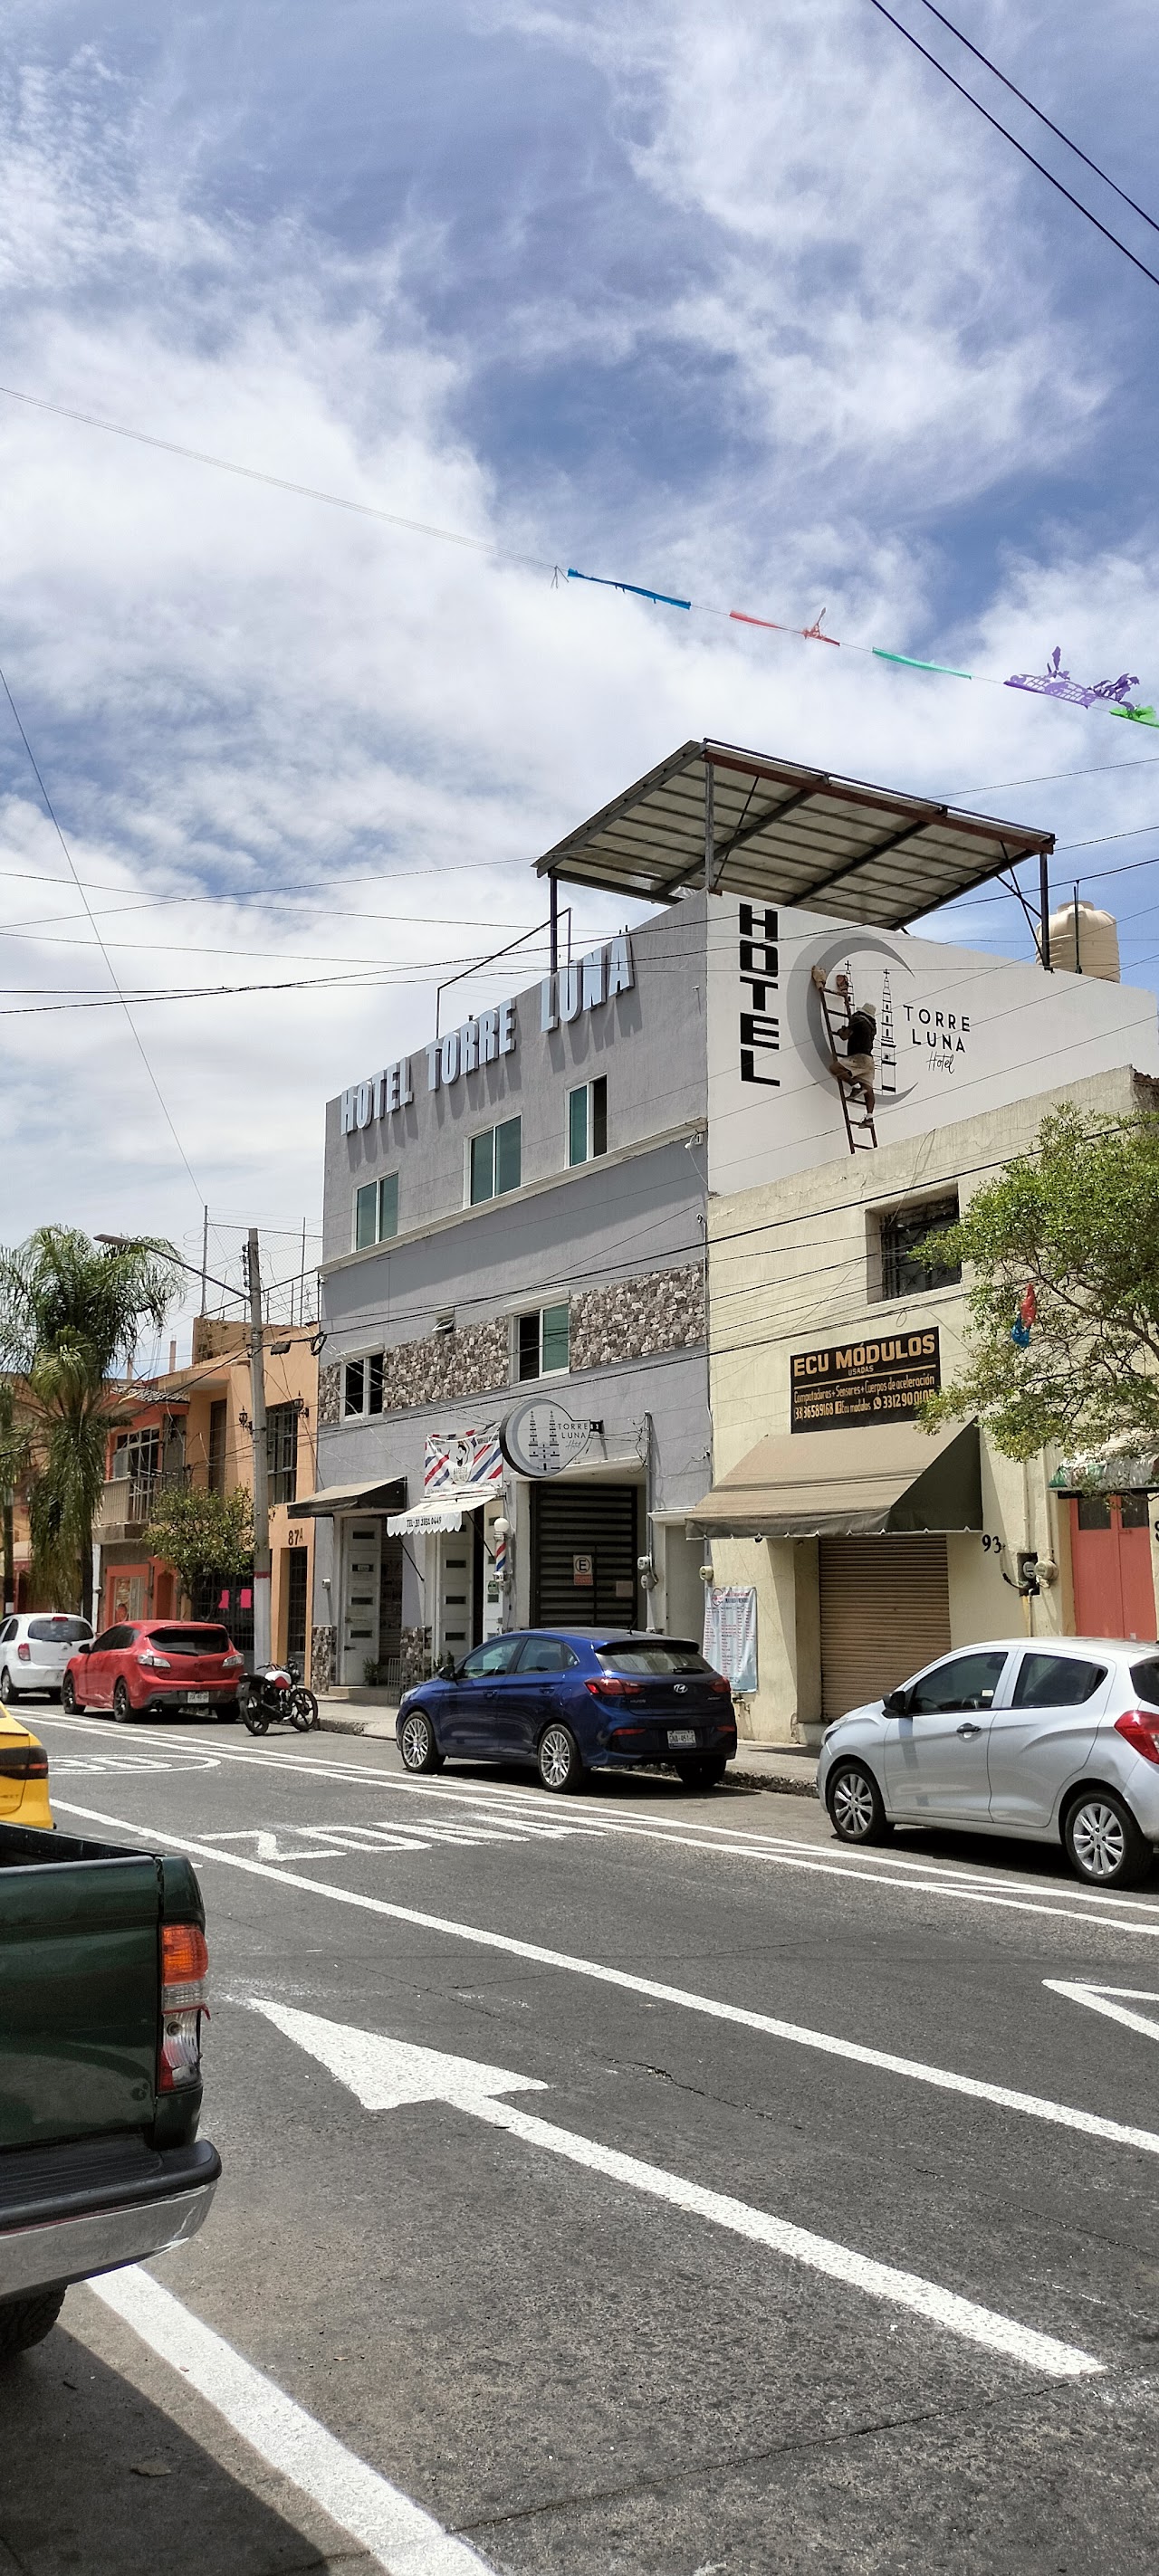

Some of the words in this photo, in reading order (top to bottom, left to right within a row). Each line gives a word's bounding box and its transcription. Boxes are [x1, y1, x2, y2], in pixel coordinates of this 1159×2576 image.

[740, 902, 780, 1087] HOTEL
[903, 1005, 971, 1032] TORRE
[340, 1056, 414, 1136] HOTEL
[426, 997, 516, 1092] TORRE
[541, 932, 635, 1034] LUNA
[912, 1028, 966, 1053] LUNA
[926, 1051, 955, 1074] Hotel
[793, 1353, 829, 1377] ECU
[836, 1333, 935, 1369] MÓDULOS
[848, 1365, 874, 1376] USADAS
[865, 1380, 887, 1395] Cuerpos
[982, 1534, 1002, 1553] 93
[579, 1560, 587, 1571] E
[197, 1814, 608, 1862] ZONA
